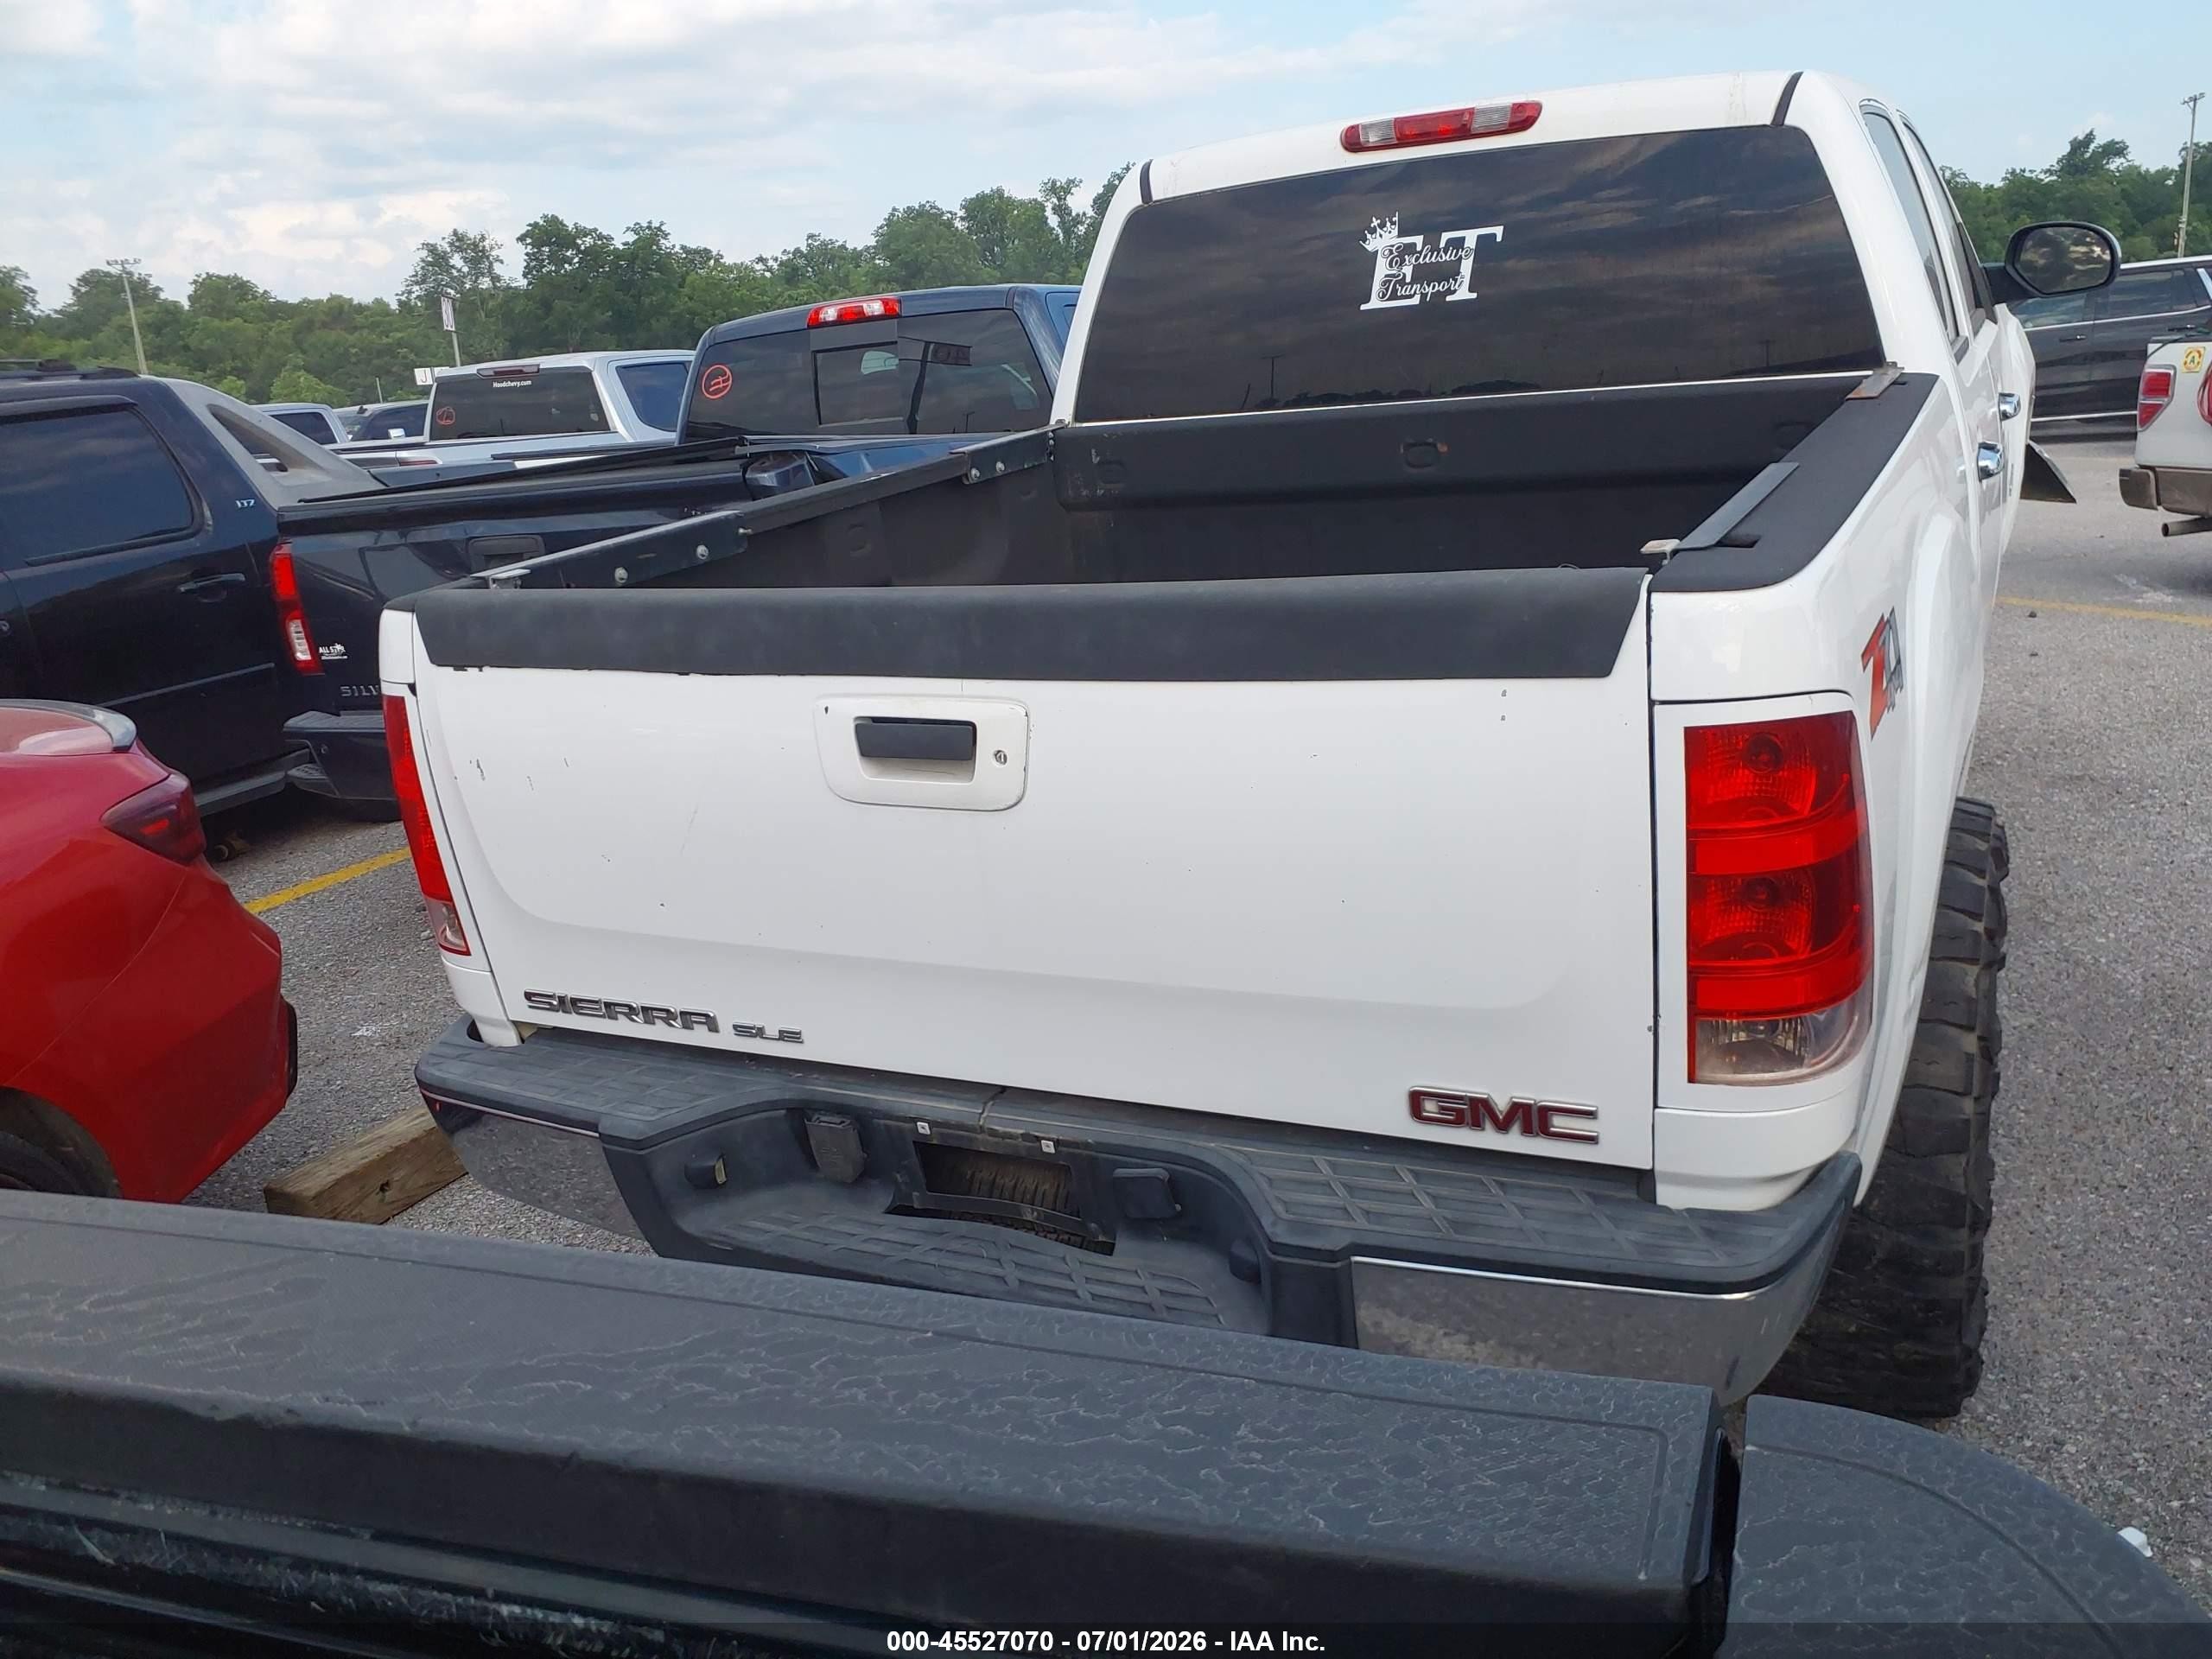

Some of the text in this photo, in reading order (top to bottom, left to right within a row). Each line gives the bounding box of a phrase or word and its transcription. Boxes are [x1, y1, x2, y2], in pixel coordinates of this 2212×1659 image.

[1381, 242, 1475, 272] Exclusive
[1376, 270, 1466, 302] Transport
[524, 988, 804, 1044] SIERRA SLE
[1408, 1085, 1599, 1144] GMC
